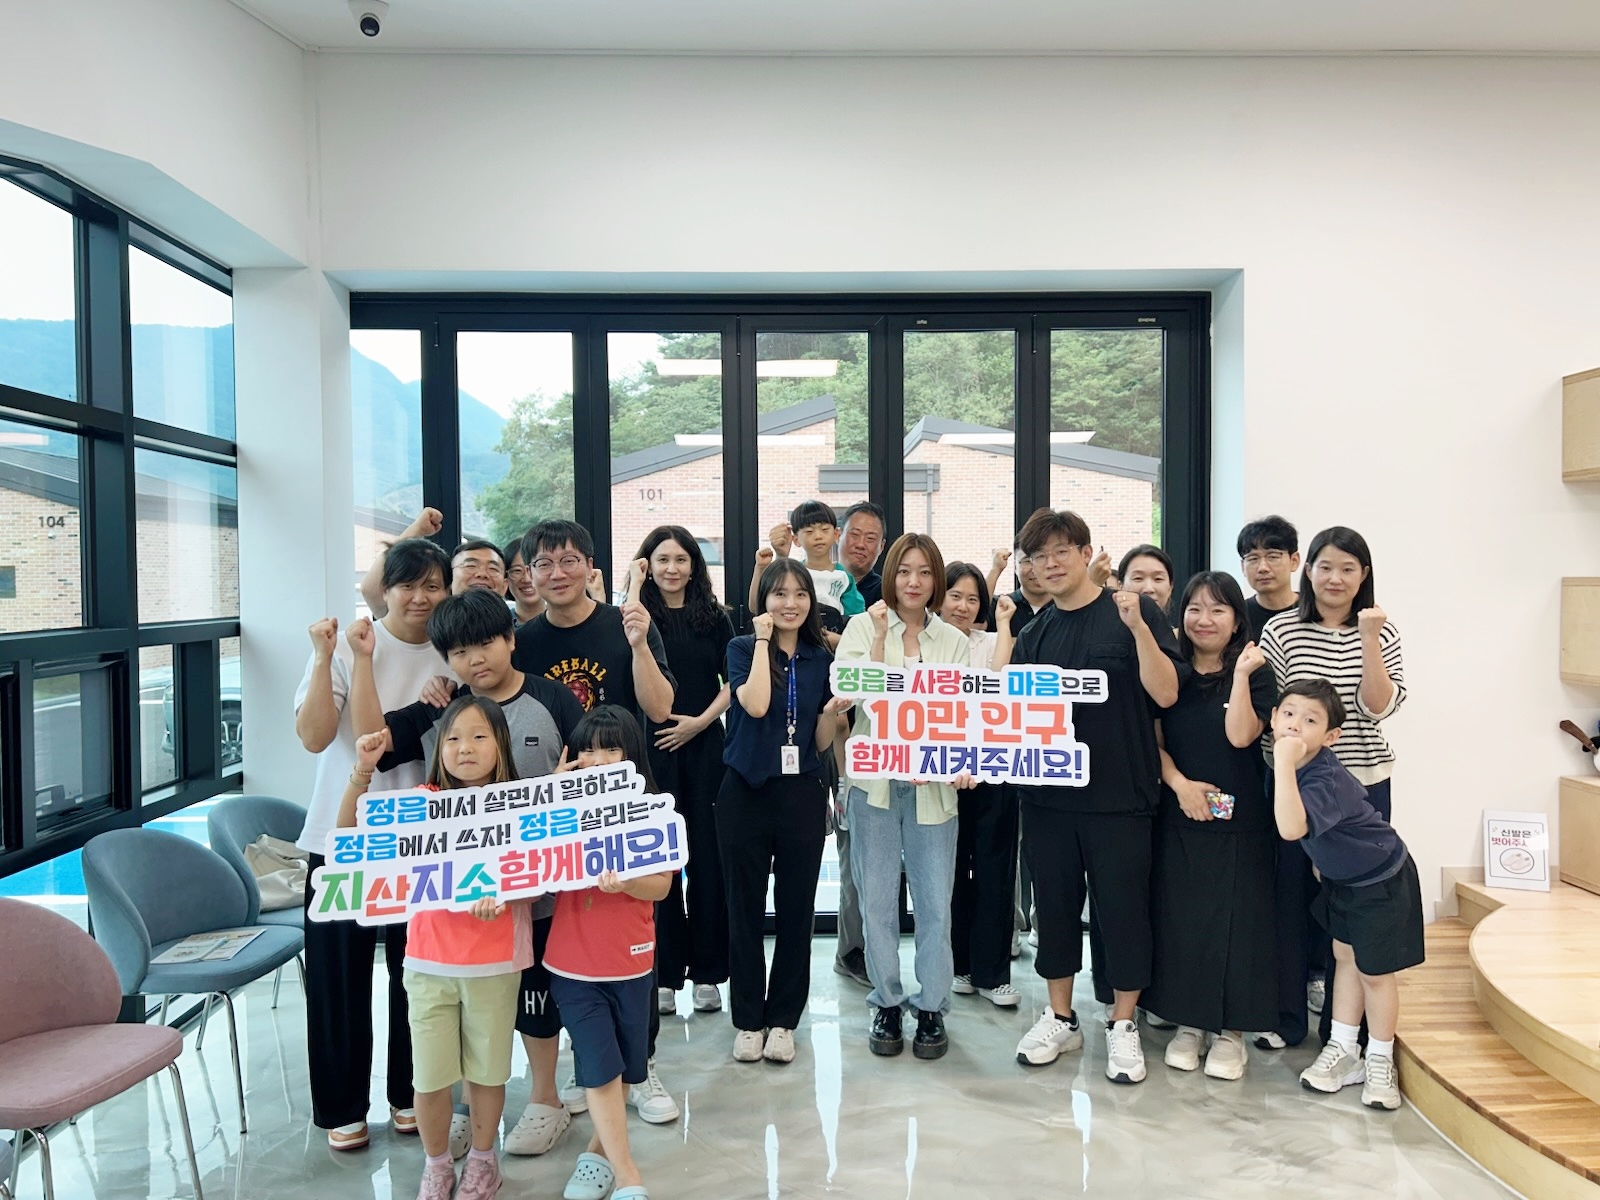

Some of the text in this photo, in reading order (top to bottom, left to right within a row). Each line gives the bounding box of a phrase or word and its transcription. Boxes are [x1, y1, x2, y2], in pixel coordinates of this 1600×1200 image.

[639, 488, 662, 500] 101
[38, 516, 65, 528] 104
[543, 658, 607, 681] IREBALL
[836, 667, 1101, 697] 정읍을 사랑하는 마음으로
[869, 700, 1067, 745] 10만 인구
[852, 742, 1083, 780] 함께 지켜주세요!
[365, 768, 638, 826] 정읍에서 살면서 일하고,
[333, 831, 448, 864] 정읍에서
[455, 823, 512, 851] 쓰자!
[1501, 829, 1531, 839] 신발은
